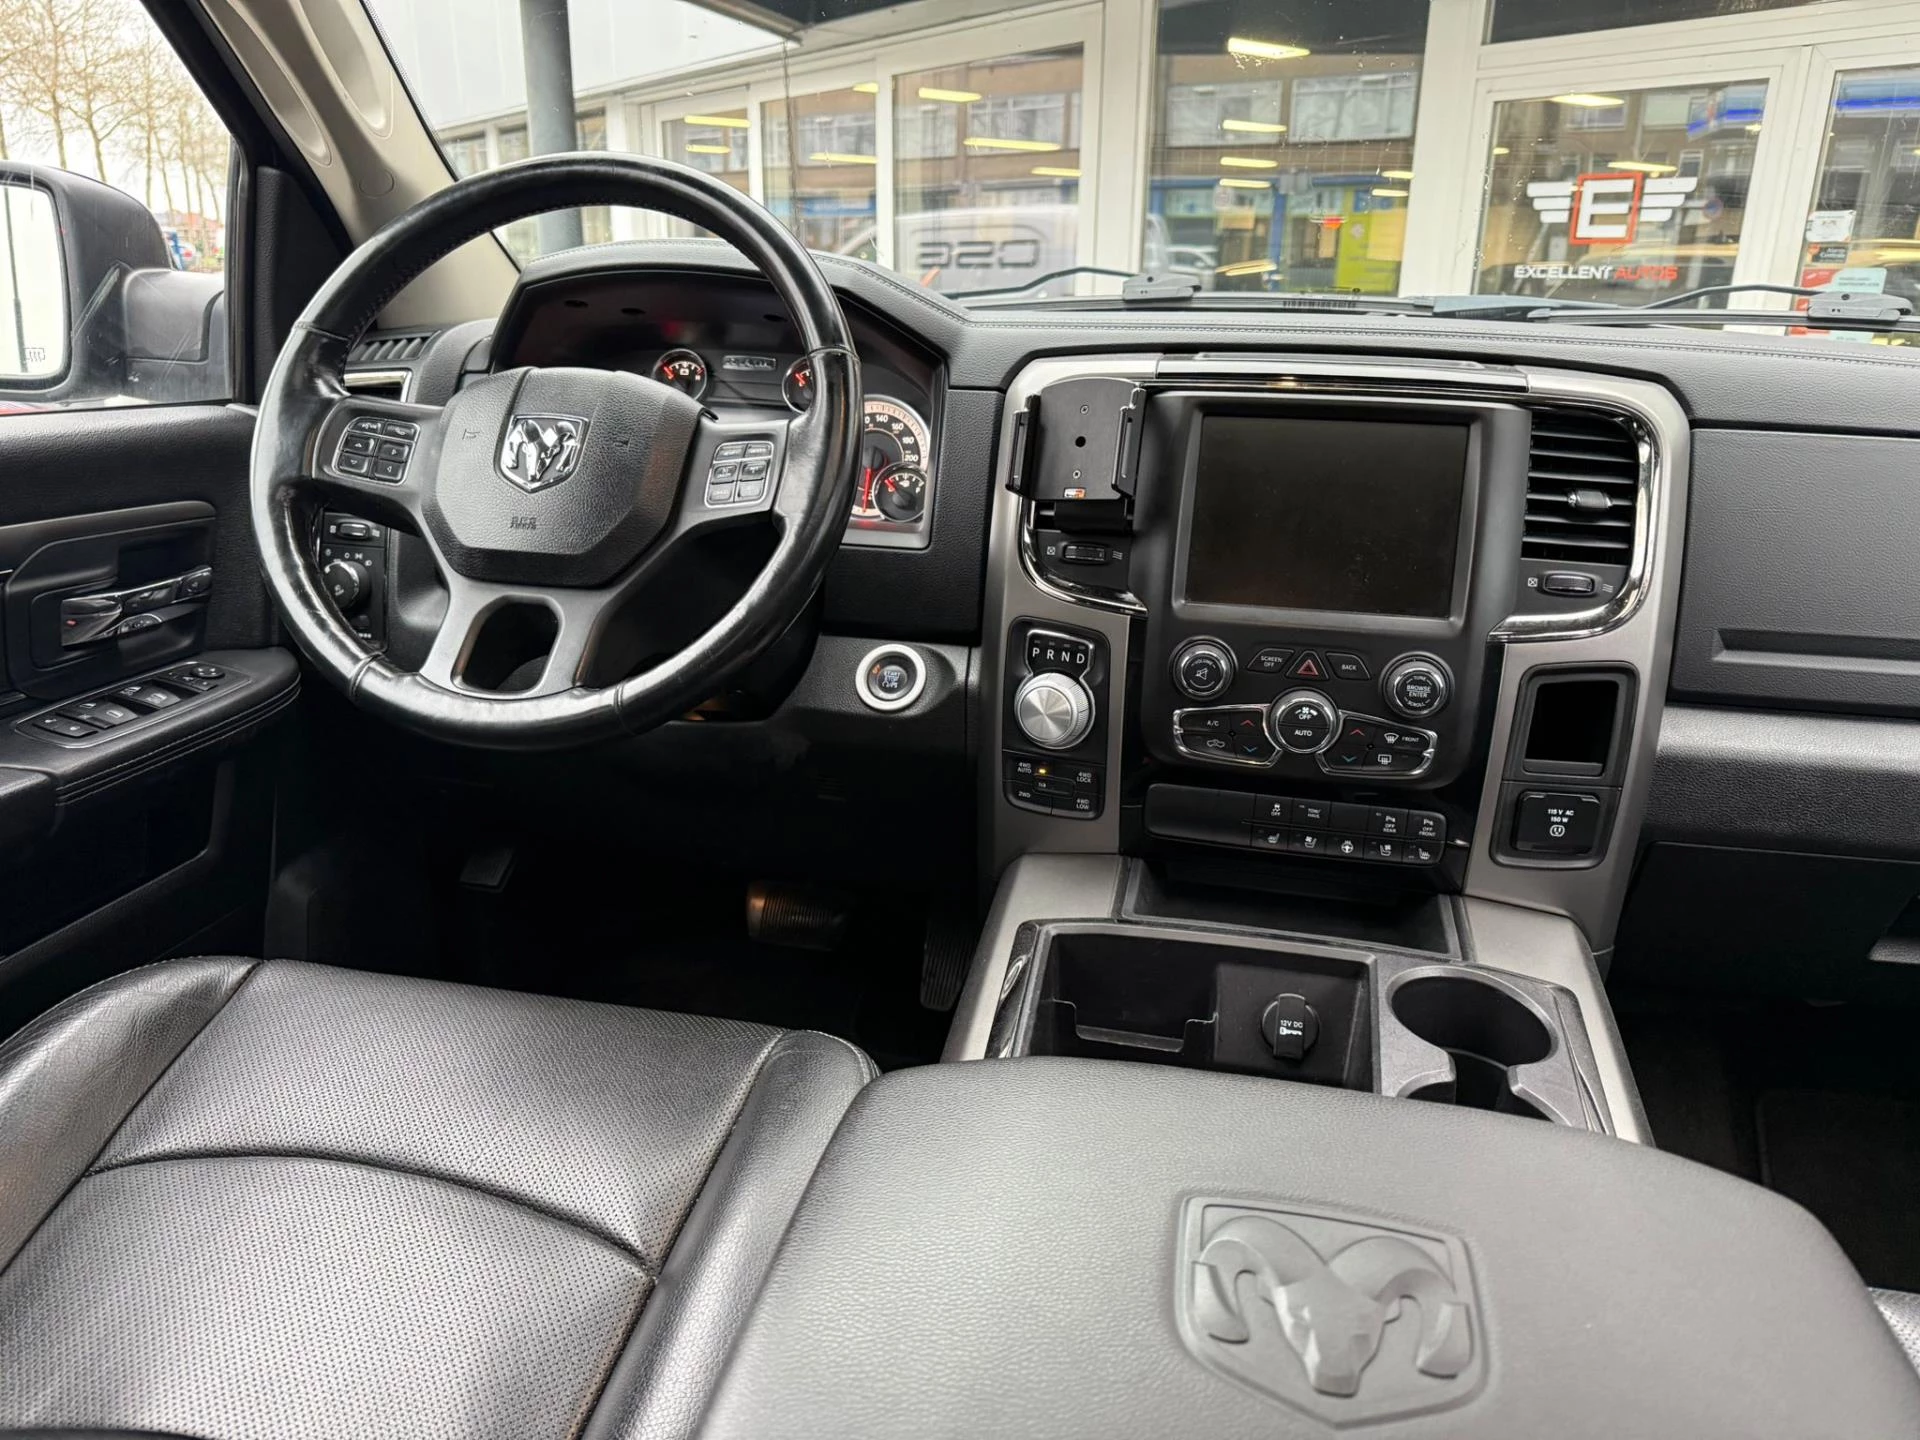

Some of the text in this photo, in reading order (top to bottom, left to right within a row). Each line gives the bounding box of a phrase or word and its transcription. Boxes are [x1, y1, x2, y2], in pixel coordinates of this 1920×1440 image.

[1514, 265, 1679, 281] EXCELLENT AUTOS
[876, 414, 888, 423] 140
[891, 423, 904, 431] 160
[904, 454, 918, 462] 200
[1032, 647, 1085, 664] P R N D
[1260, 655, 1283, 663] SCREEN
[1341, 663, 1357, 671] BACK
[1406, 684, 1431, 692] BROWSE
[1299, 713, 1312, 721] OFF
[1207, 719, 1220, 727] A/C
[1294, 729, 1313, 737] AUTO
